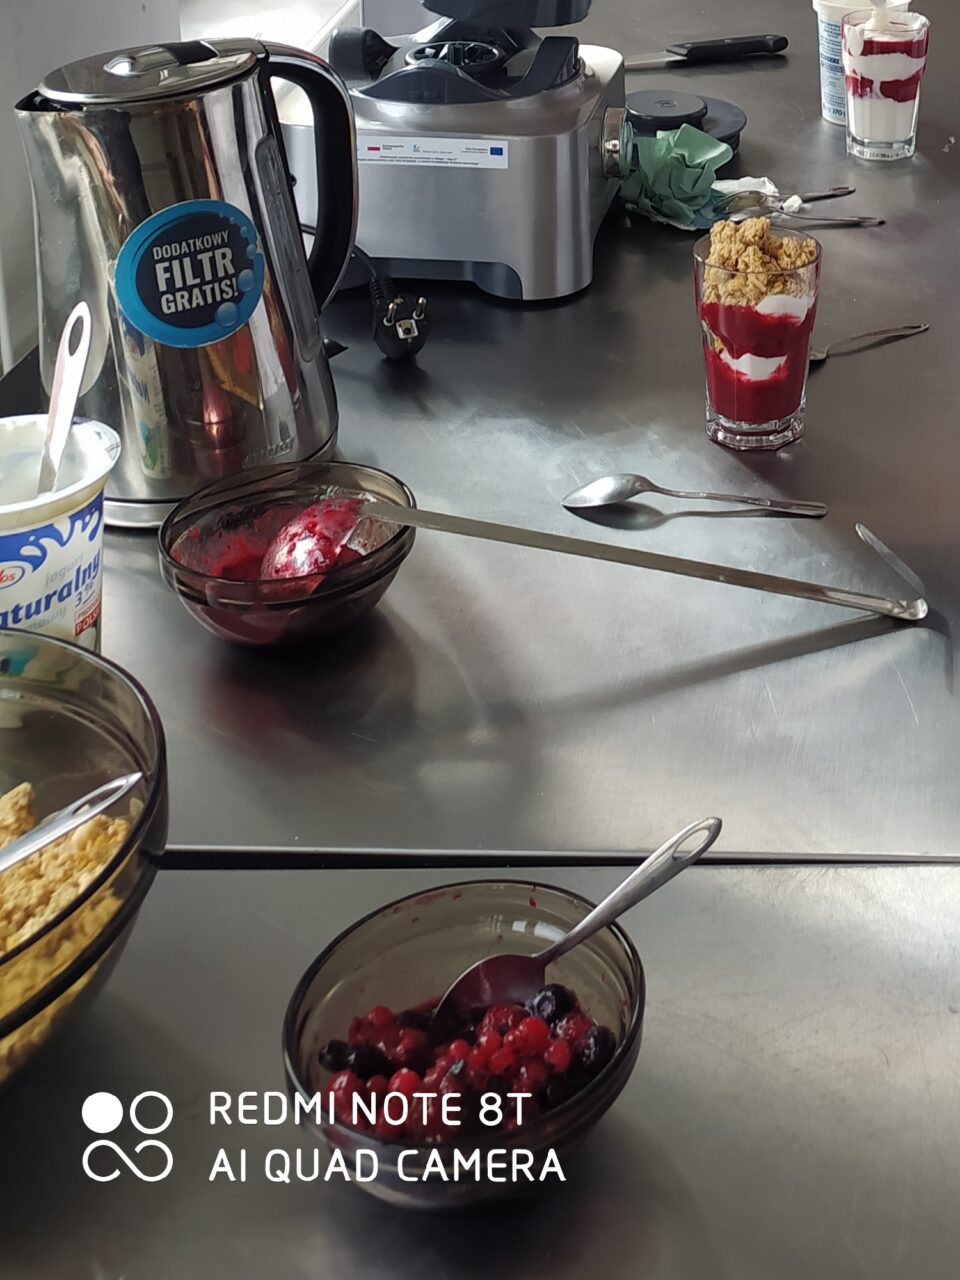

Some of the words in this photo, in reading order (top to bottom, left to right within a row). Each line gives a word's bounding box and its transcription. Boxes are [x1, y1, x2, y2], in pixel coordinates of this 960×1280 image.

[152, 230, 229, 260] DODATKOWY
[155, 247, 235, 293] FILTR
[160, 277, 239, 314] GRATIS!
[0, 548, 101, 629] aturalny
